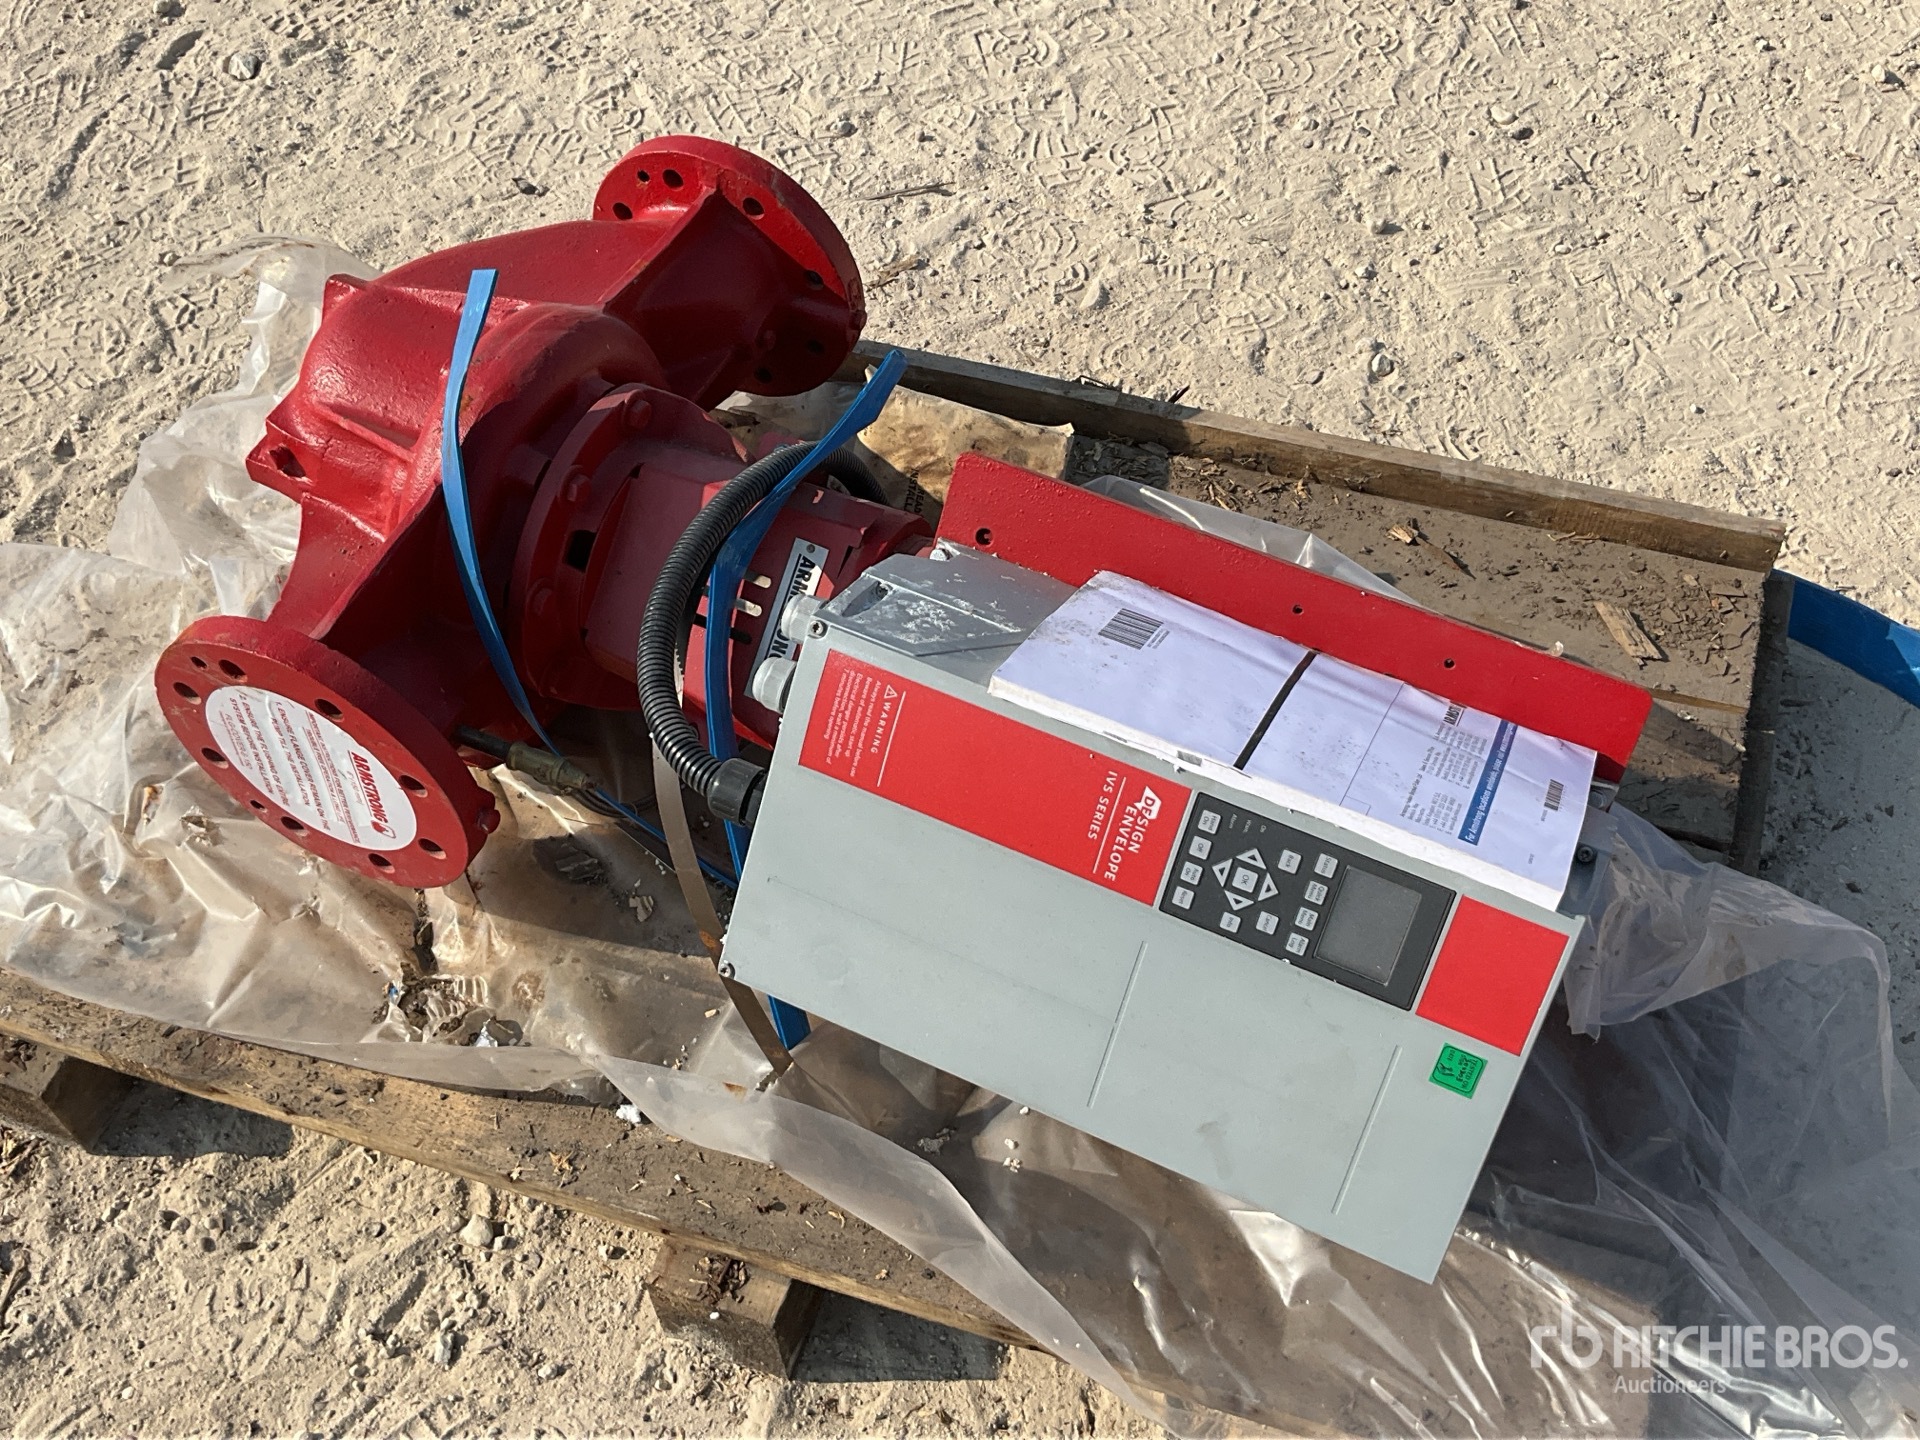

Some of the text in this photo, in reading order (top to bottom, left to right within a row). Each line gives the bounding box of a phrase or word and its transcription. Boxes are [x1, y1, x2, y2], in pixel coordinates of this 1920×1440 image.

[836, 673, 847, 697] minutes
[850, 673, 863, 701] Electrical
[862, 677, 872, 699] Beware
[870, 680, 881, 702] Always
[831, 697, 840, 716] before
[845, 700, 854, 720] danger
[866, 703, 874, 716] read
[824, 716, 834, 739] opening
[851, 706, 862, 734] automatic
[871, 702, 891, 753] WARNING
[838, 721, 848, 743] persists
[858, 727, 867, 748] manual
[230, 698, 274, 794] SYSTEM BEFORE INSTALLATION
[242, 702, 258, 728] ENSURE
[256, 731, 264, 741] THE
[260, 743, 278, 774] FLUSHING
[272, 775, 281, 783] OF
[828, 730, 838, 756] minimum
[853, 748, 862, 766] before
[278, 707, 294, 734] ENSURE
[289, 735, 305, 761] FLANGE
[300, 761, 314, 782] COVER
[309, 783, 322, 808] REMAIN
[317, 808, 324, 818] ON
[321, 819, 331, 831] THE
[286, 752, 294, 763] THE
[290, 763, 310, 806] INSTALLATION
[351, 752, 388, 823] ARMSTRONG
[338, 788, 348, 808] BETTER
[1088, 771, 1118, 840] IVS SERIES
[1202, 816, 1209, 825] On
[1229, 814, 1237, 829] Alarm
[1468, 810, 1485, 834] Armstrong
[1477, 790, 1491, 811] locations
[1128, 795, 1156, 853] DESIGN
[1208, 816, 1217, 831] Hand
[1104, 806, 1137, 881] ENVELOPE
[1185, 867, 1191, 876] On
[1285, 855, 1294, 868] Back
[1321, 857, 1331, 874] Status
[1190, 868, 1198, 880] Auto
[1241, 874, 1249, 885] OK
[1179, 890, 1187, 904] Reset
[1308, 883, 1317, 899] Menu
[1315, 886, 1324, 901] Quick
[1226, 917, 1234, 927] Info
[1263, 915, 1272, 931] Cancel
[1298, 910, 1307, 924] Menu
[1306, 913, 1314, 927] Main
[1288, 937, 1297, 948] Log
[1296, 938, 1305, 953] Alarm
